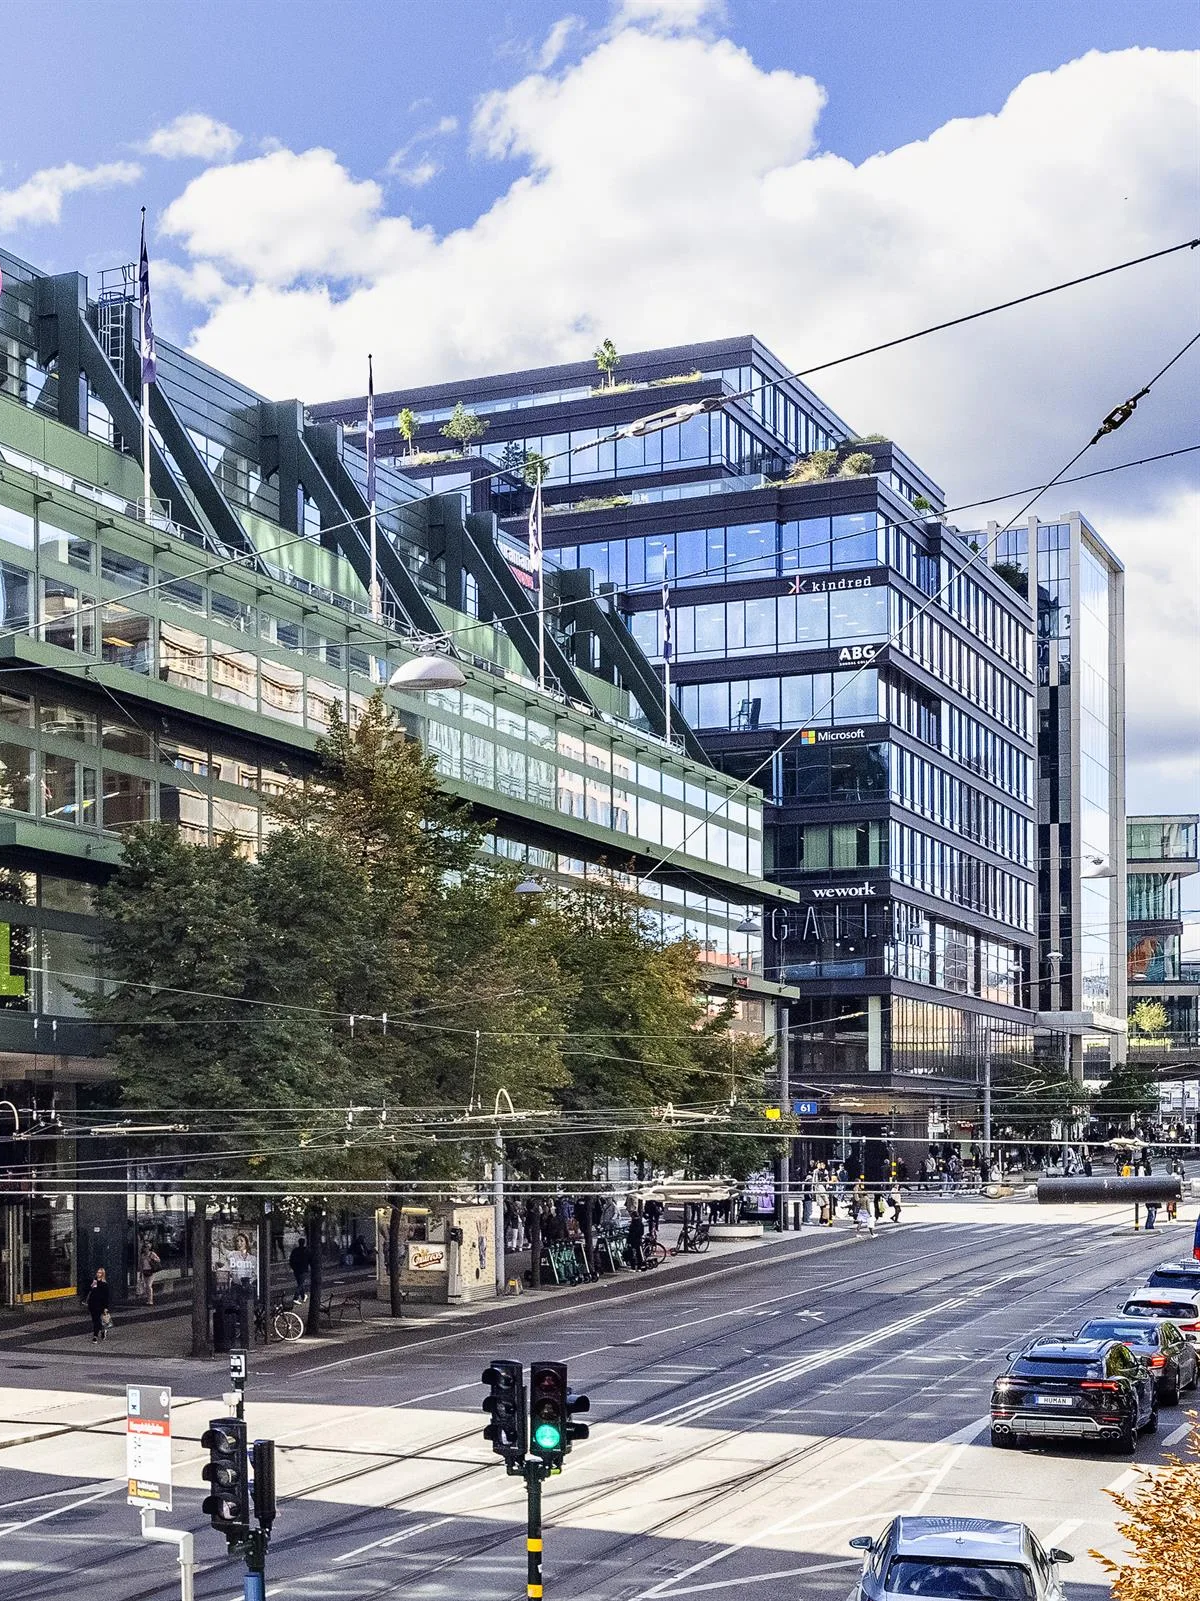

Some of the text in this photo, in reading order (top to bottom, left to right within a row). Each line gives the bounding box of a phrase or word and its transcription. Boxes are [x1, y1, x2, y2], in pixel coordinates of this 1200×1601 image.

[812, 576, 872, 592] kindred
[839, 645, 876, 661] ABG
[818, 729, 865, 741] Microsoft
[812, 882, 877, 898] wework
[800, 1103, 811, 1112] 61
